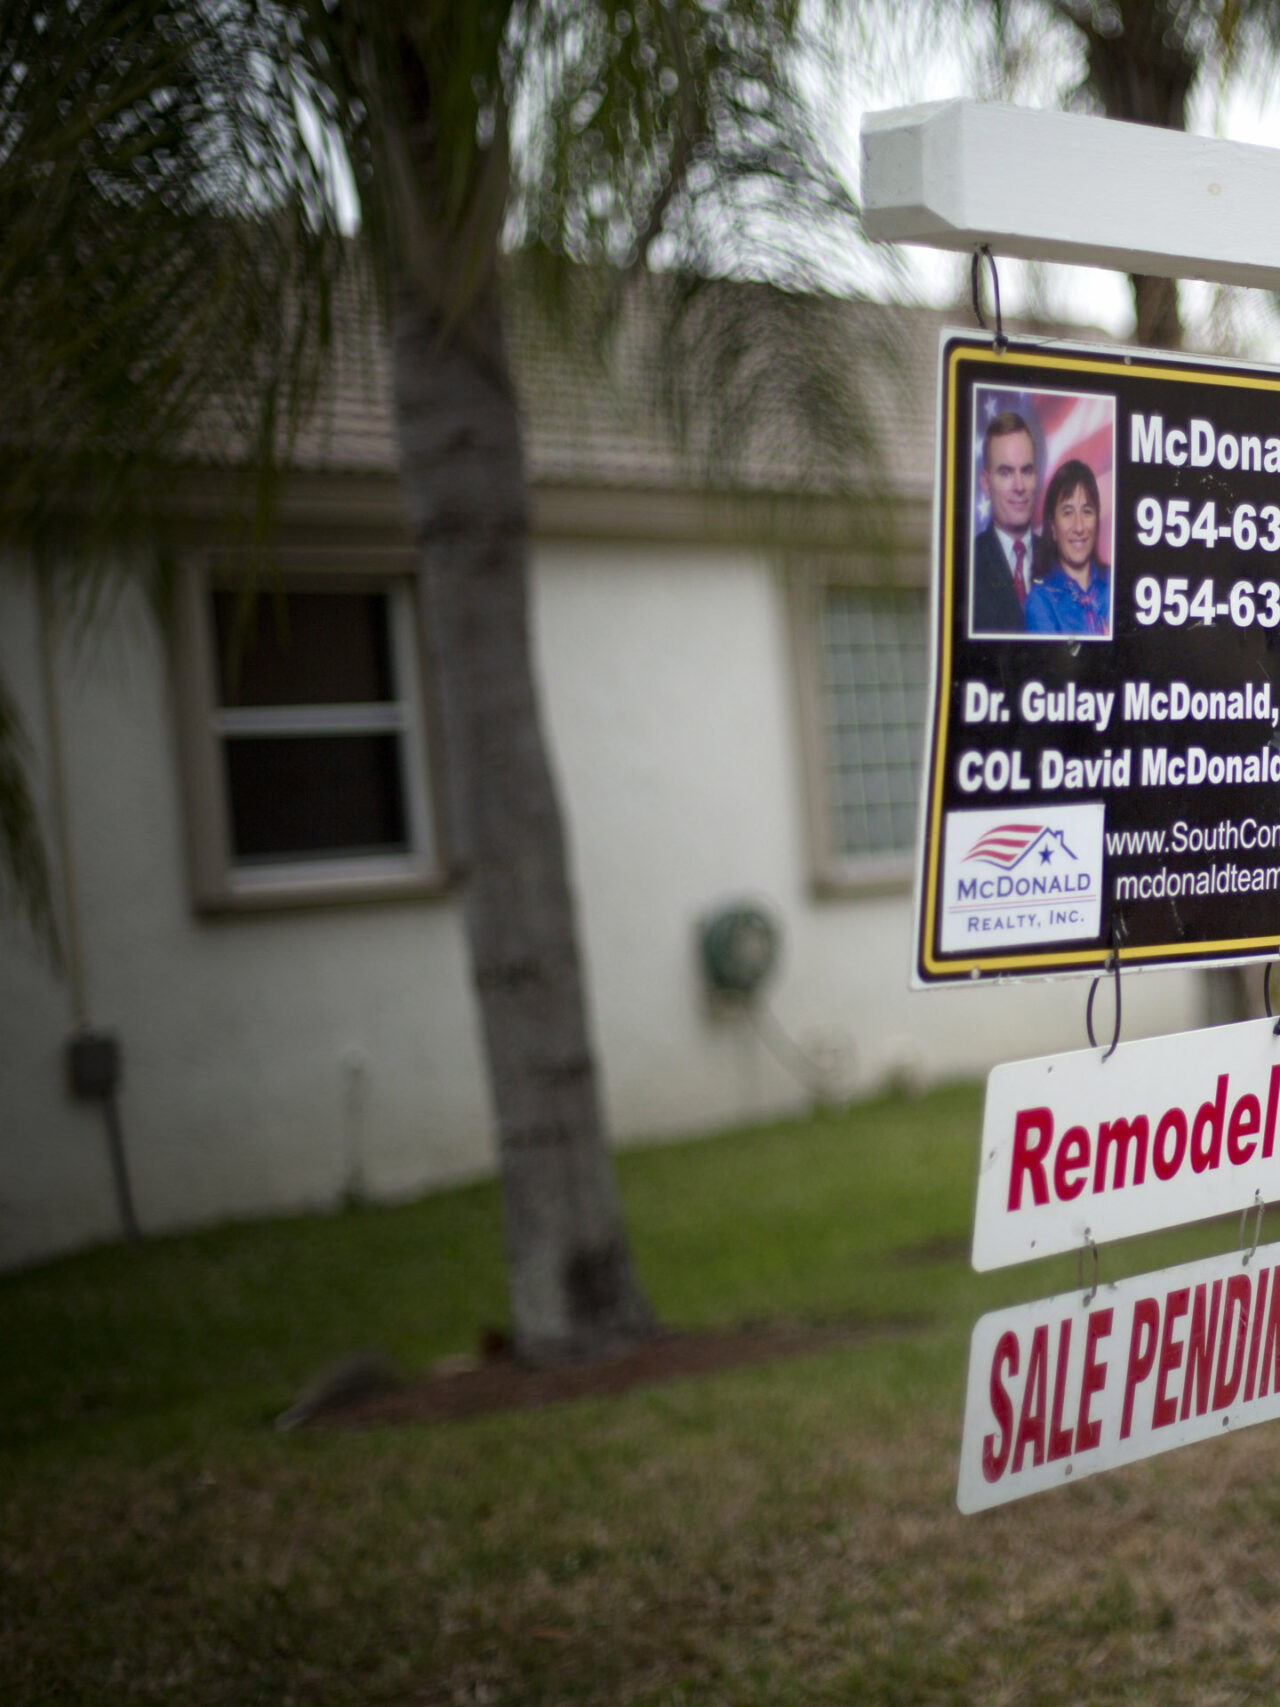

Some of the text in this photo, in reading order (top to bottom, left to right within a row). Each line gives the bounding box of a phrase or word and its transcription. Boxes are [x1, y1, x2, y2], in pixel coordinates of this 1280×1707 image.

[964, 682, 1010, 723] Dr.
[1021, 682, 1114, 731] Gulay
[1124, 682, 1279, 727] McDonald,
[958, 750, 1031, 793] COL
[1041, 749, 1131, 789] David
[981, 1307, 1114, 1483] SALE
